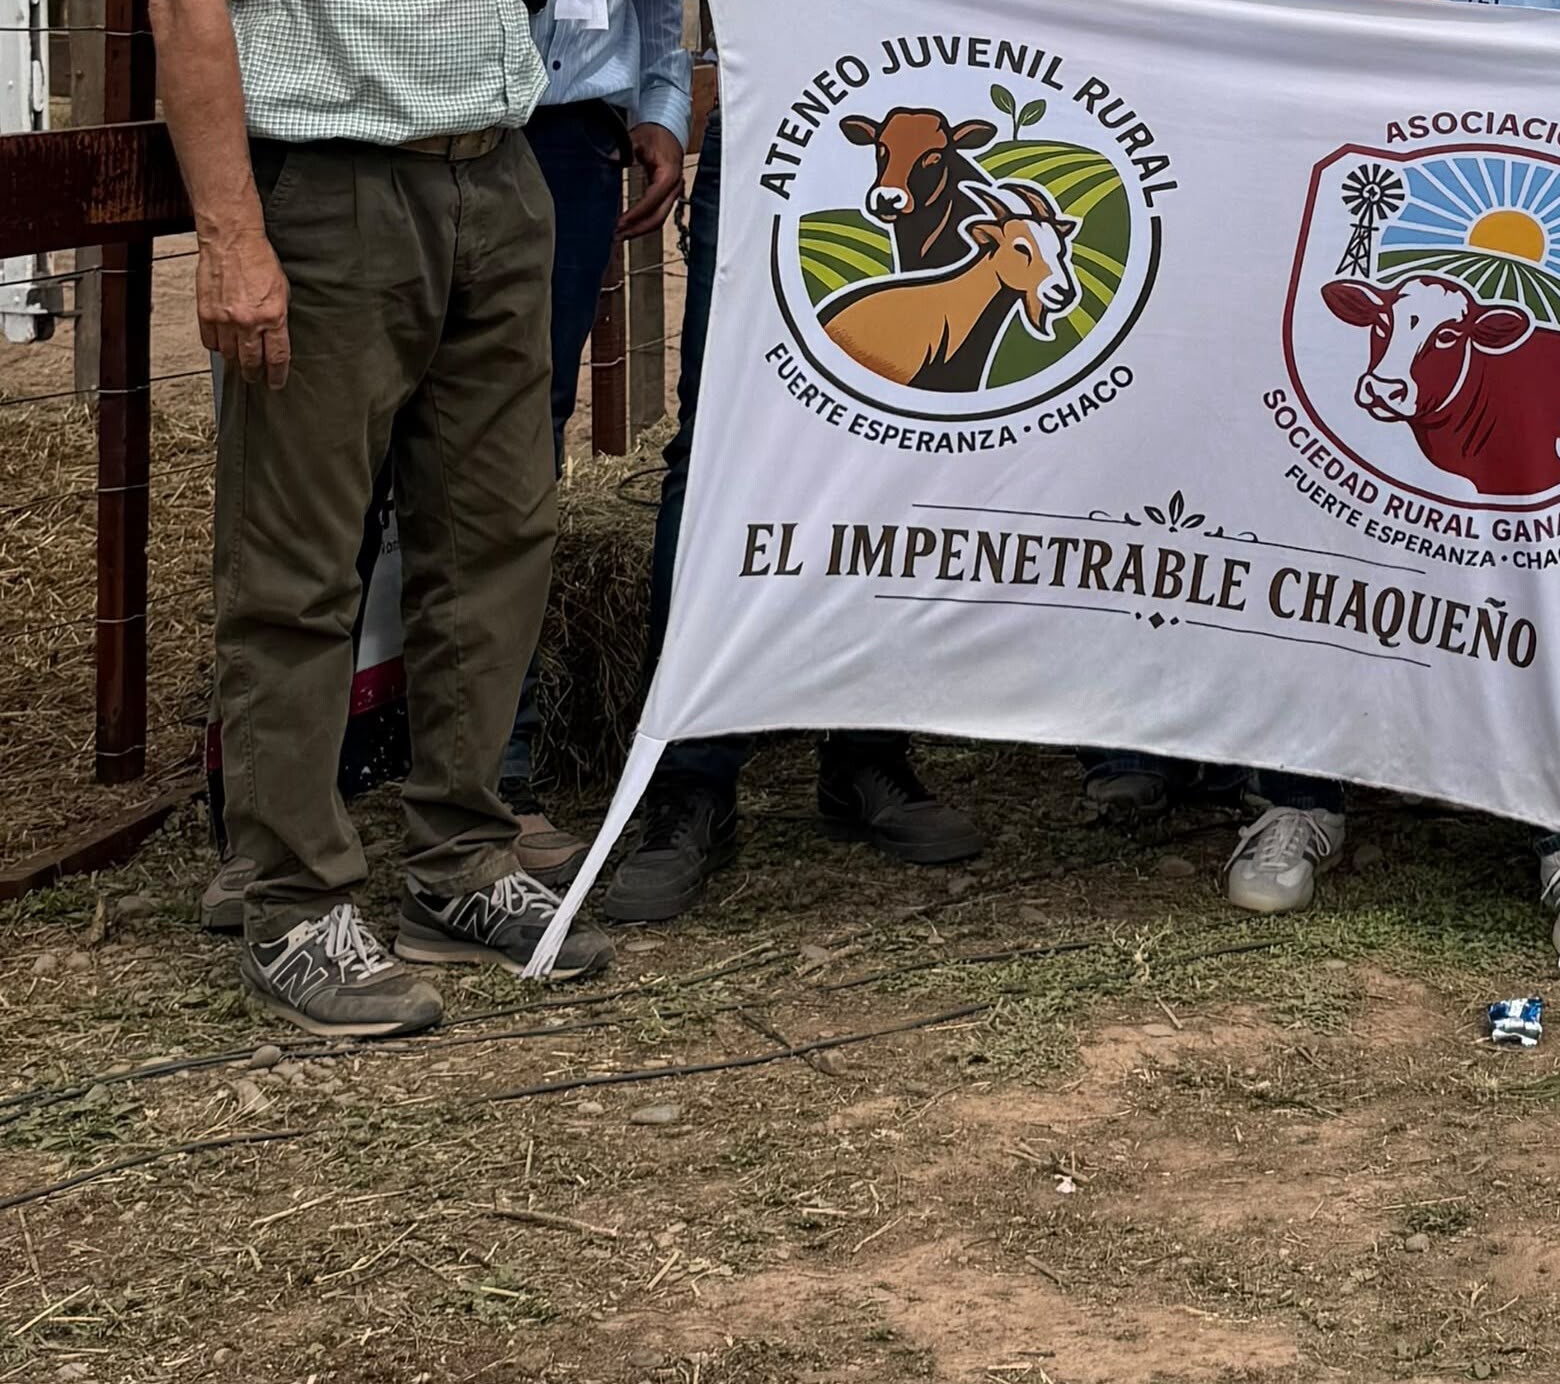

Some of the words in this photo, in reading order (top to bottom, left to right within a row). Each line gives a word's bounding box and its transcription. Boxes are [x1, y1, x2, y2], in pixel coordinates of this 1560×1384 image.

[759, 54, 870, 201] ATENEO
[881, 35, 1065, 92] JUVENIL
[1072, 76, 1178, 209] RURAL
[764, 342, 847, 427] FUERTE
[848, 412, 1018, 454] ESPERANZA
[1037, 364, 1134, 436] CHACO
[1263, 389, 1379, 513] SOCIEDAD
[1385, 497, 1481, 541] RURAL
[1284, 464, 1360, 529] FUERTE
[1364, 519, 1498, 569] ESPERANZA
[738, 523, 804, 578] EL
[825, 524, 1250, 612] IMPENETRABLE
[1267, 567, 1538, 670] CHAQUEÑO
